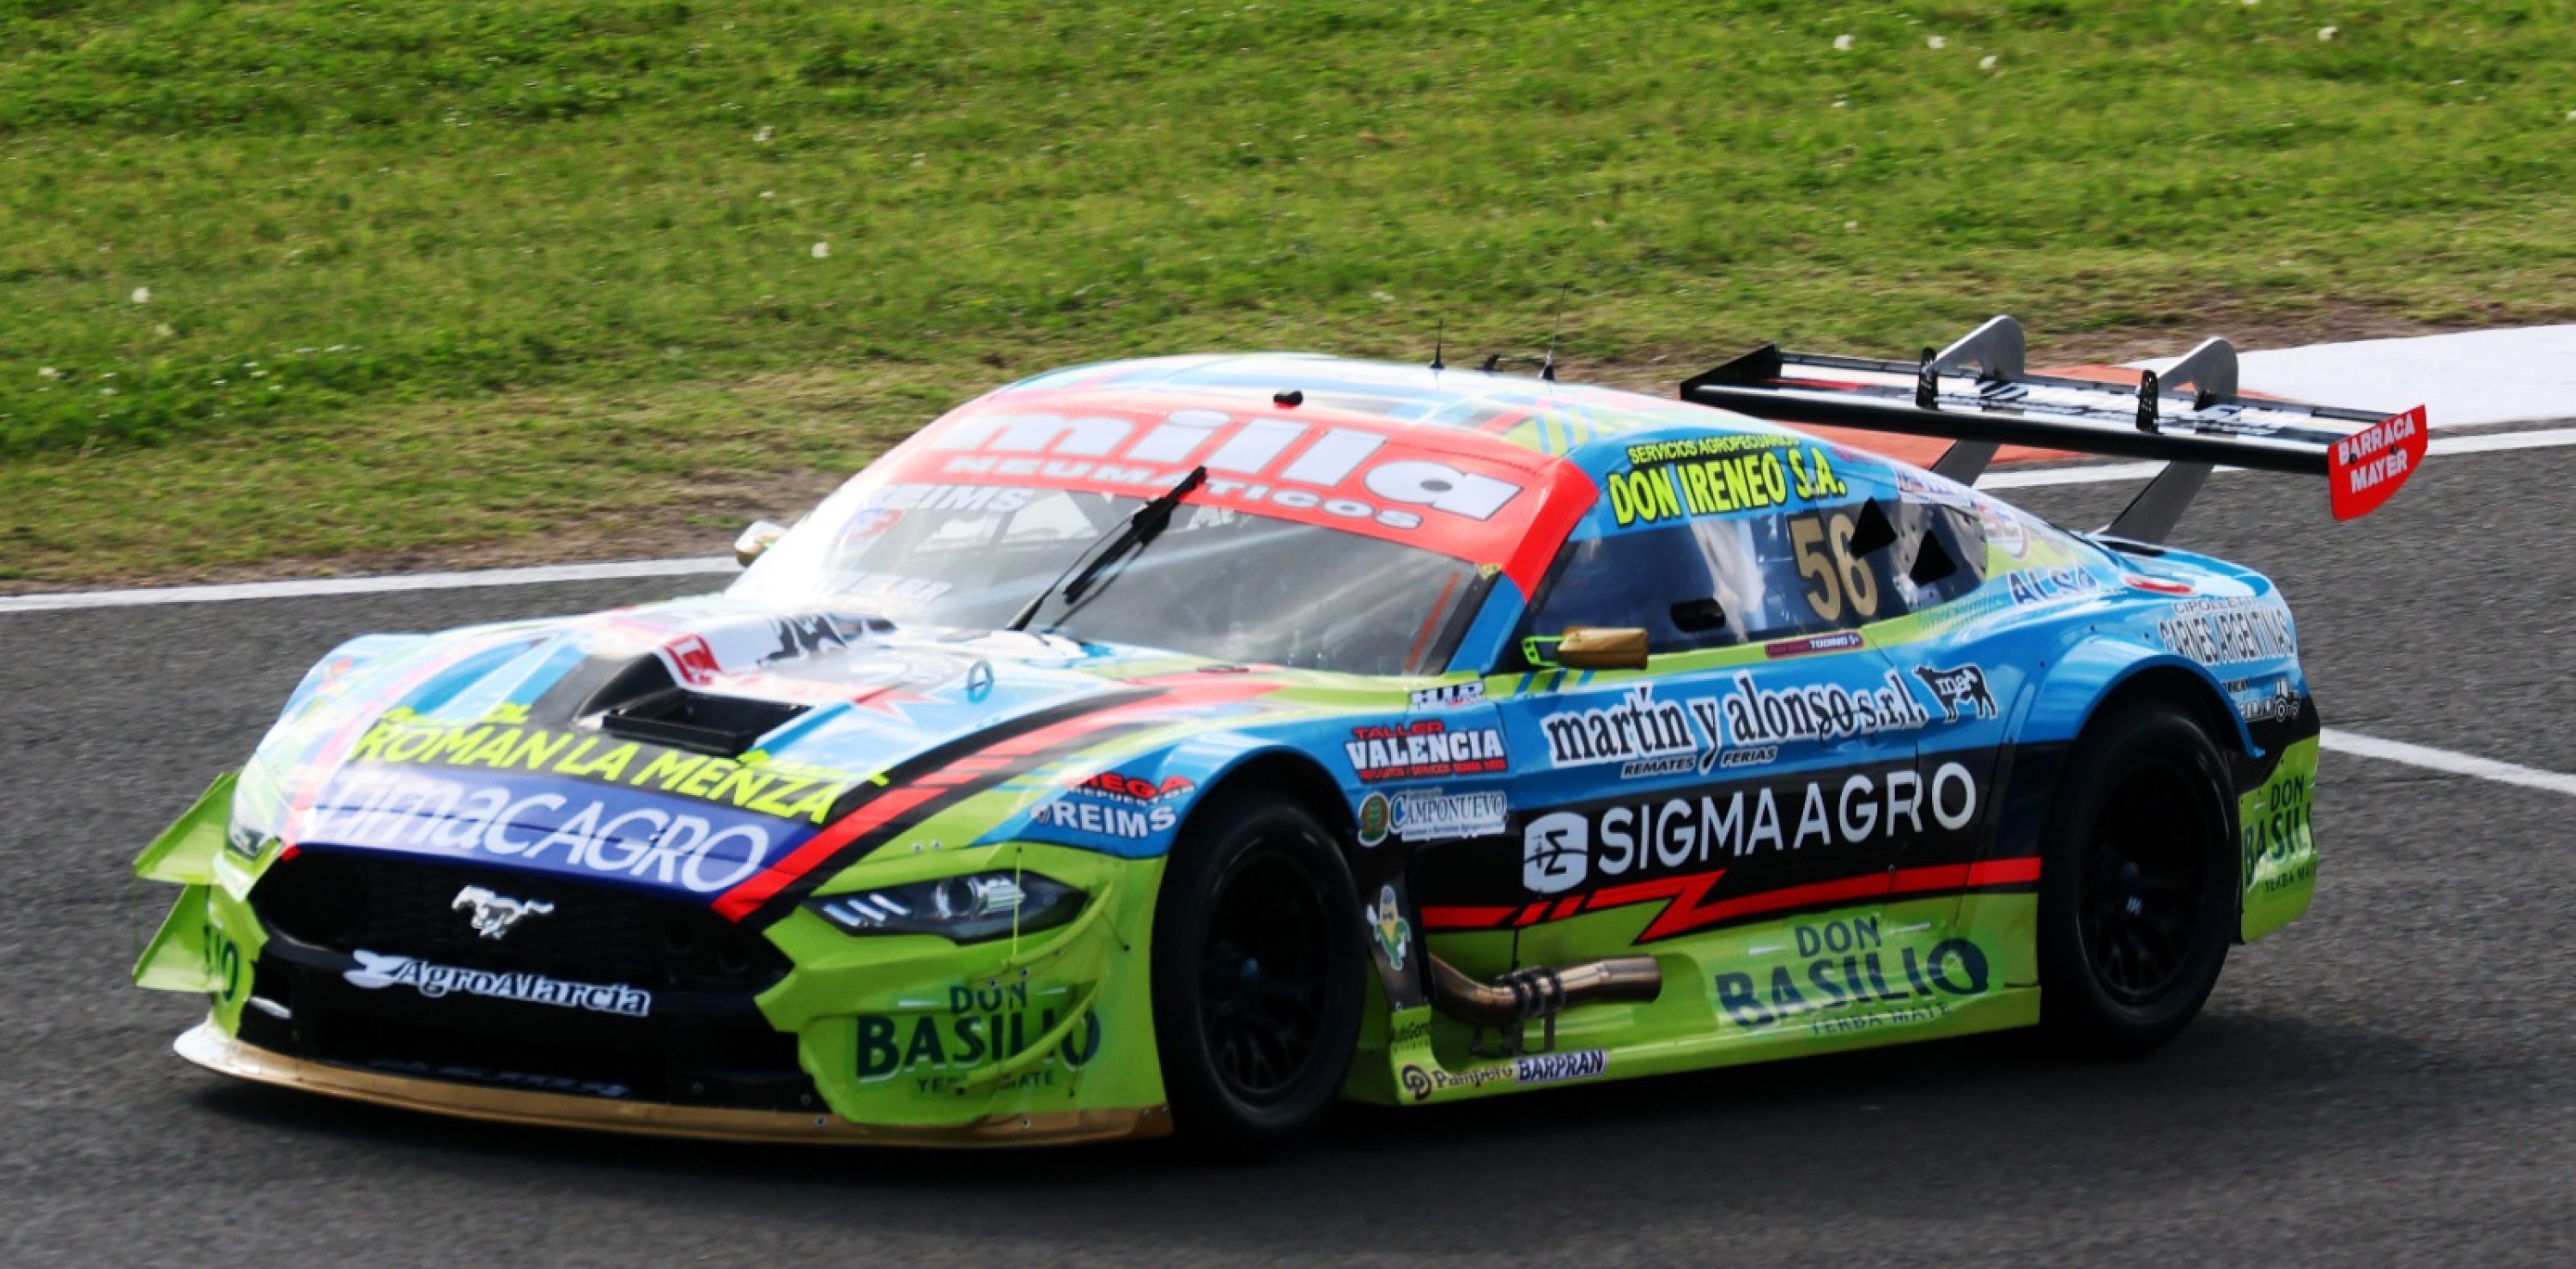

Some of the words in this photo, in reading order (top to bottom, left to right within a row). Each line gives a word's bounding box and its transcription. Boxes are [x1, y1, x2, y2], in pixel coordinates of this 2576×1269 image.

[1627, 439, 1698, 464] SERVICIOS
[2338, 412, 2415, 465] BARRACA
[927, 409, 1525, 521] milla
[1608, 467, 1681, 525] DON
[1677, 452, 1787, 514] IRENEO
[1788, 446, 1847, 499] S.A.
[2350, 449, 2408, 494] MAYER
[942, 457, 1425, 530] NEUMATICOS
[1789, 513, 1879, 622] 56
[2159, 617, 2219, 665] CARNES
[2214, 610, 2293, 665] ARGENTINAS
[1353, 721, 1443, 739] TALLER
[1548, 687, 1692, 762] martín
[1694, 700, 1717, 770] y
[1728, 677, 1855, 745] alonso
[1346, 730, 1504, 769] VALENCIA
[1624, 756, 1694, 776] REMATES
[1722, 748, 1775, 766] FERIAS
[349, 721, 574, 771] ROMAN
[552, 736, 641, 781] LA
[629, 749, 848, 824] MENZA
[2270, 774, 2305, 812] DON
[1390, 793, 1504, 829] CAMPONUEVO
[1795, 915, 1882, 958] DON
[950, 981, 1026, 1015] DON
[1715, 938, 1989, 1028] BASILIO
[1893, 1003, 1948, 1023] MATE
[855, 1008, 1101, 1079] BASILIO
[1517, 1049, 1604, 1081] BARPRAN
[1431, 1067, 1513, 1089] Pampero
